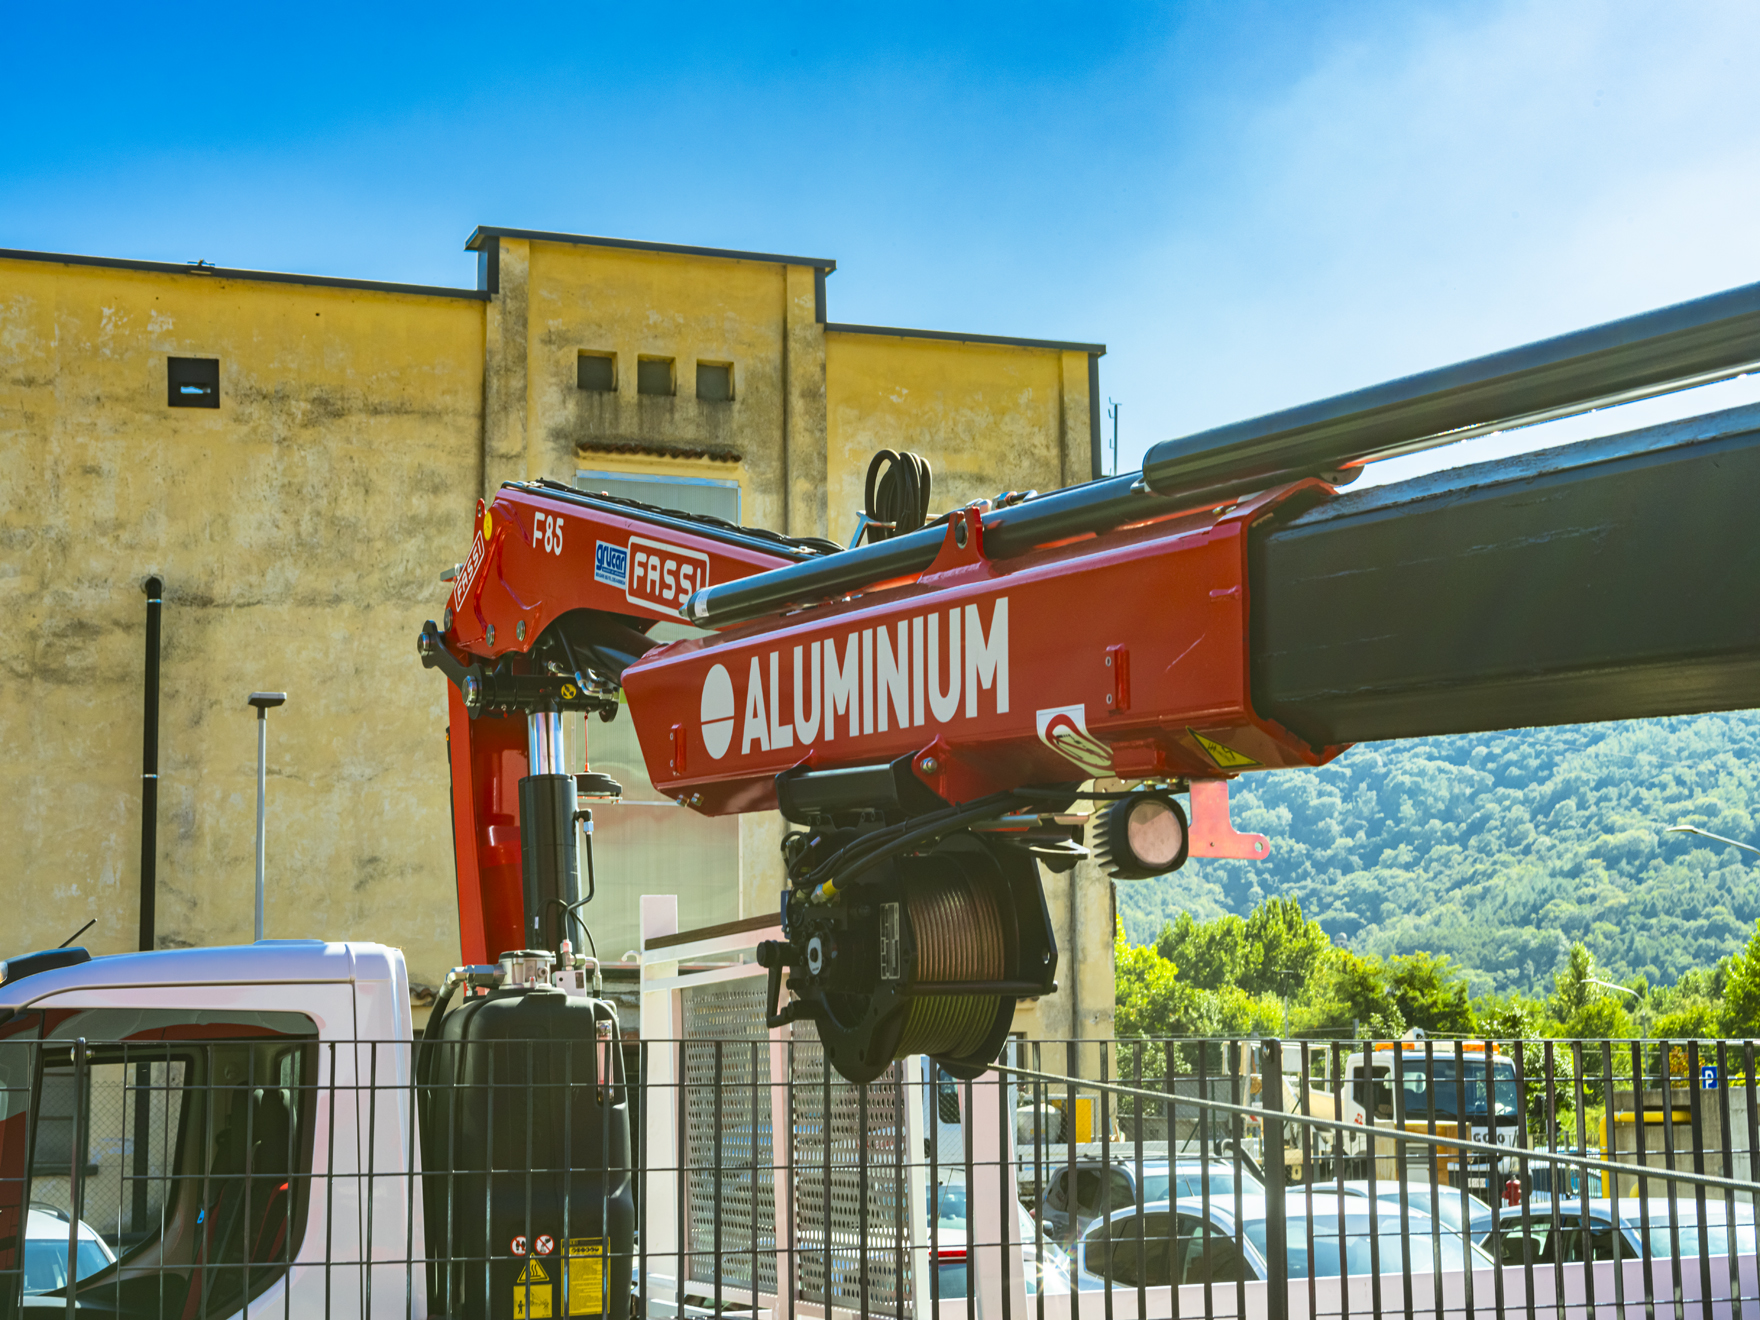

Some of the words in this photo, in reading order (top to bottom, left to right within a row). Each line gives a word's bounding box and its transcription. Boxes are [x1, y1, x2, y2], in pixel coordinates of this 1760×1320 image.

[532, 511, 565, 556] F85
[456, 540, 482, 602] FASSI
[596, 544, 626, 571] grucar
[741, 596, 1010, 755] ALUMINIUM
[1704, 1070, 1714, 1089] P
